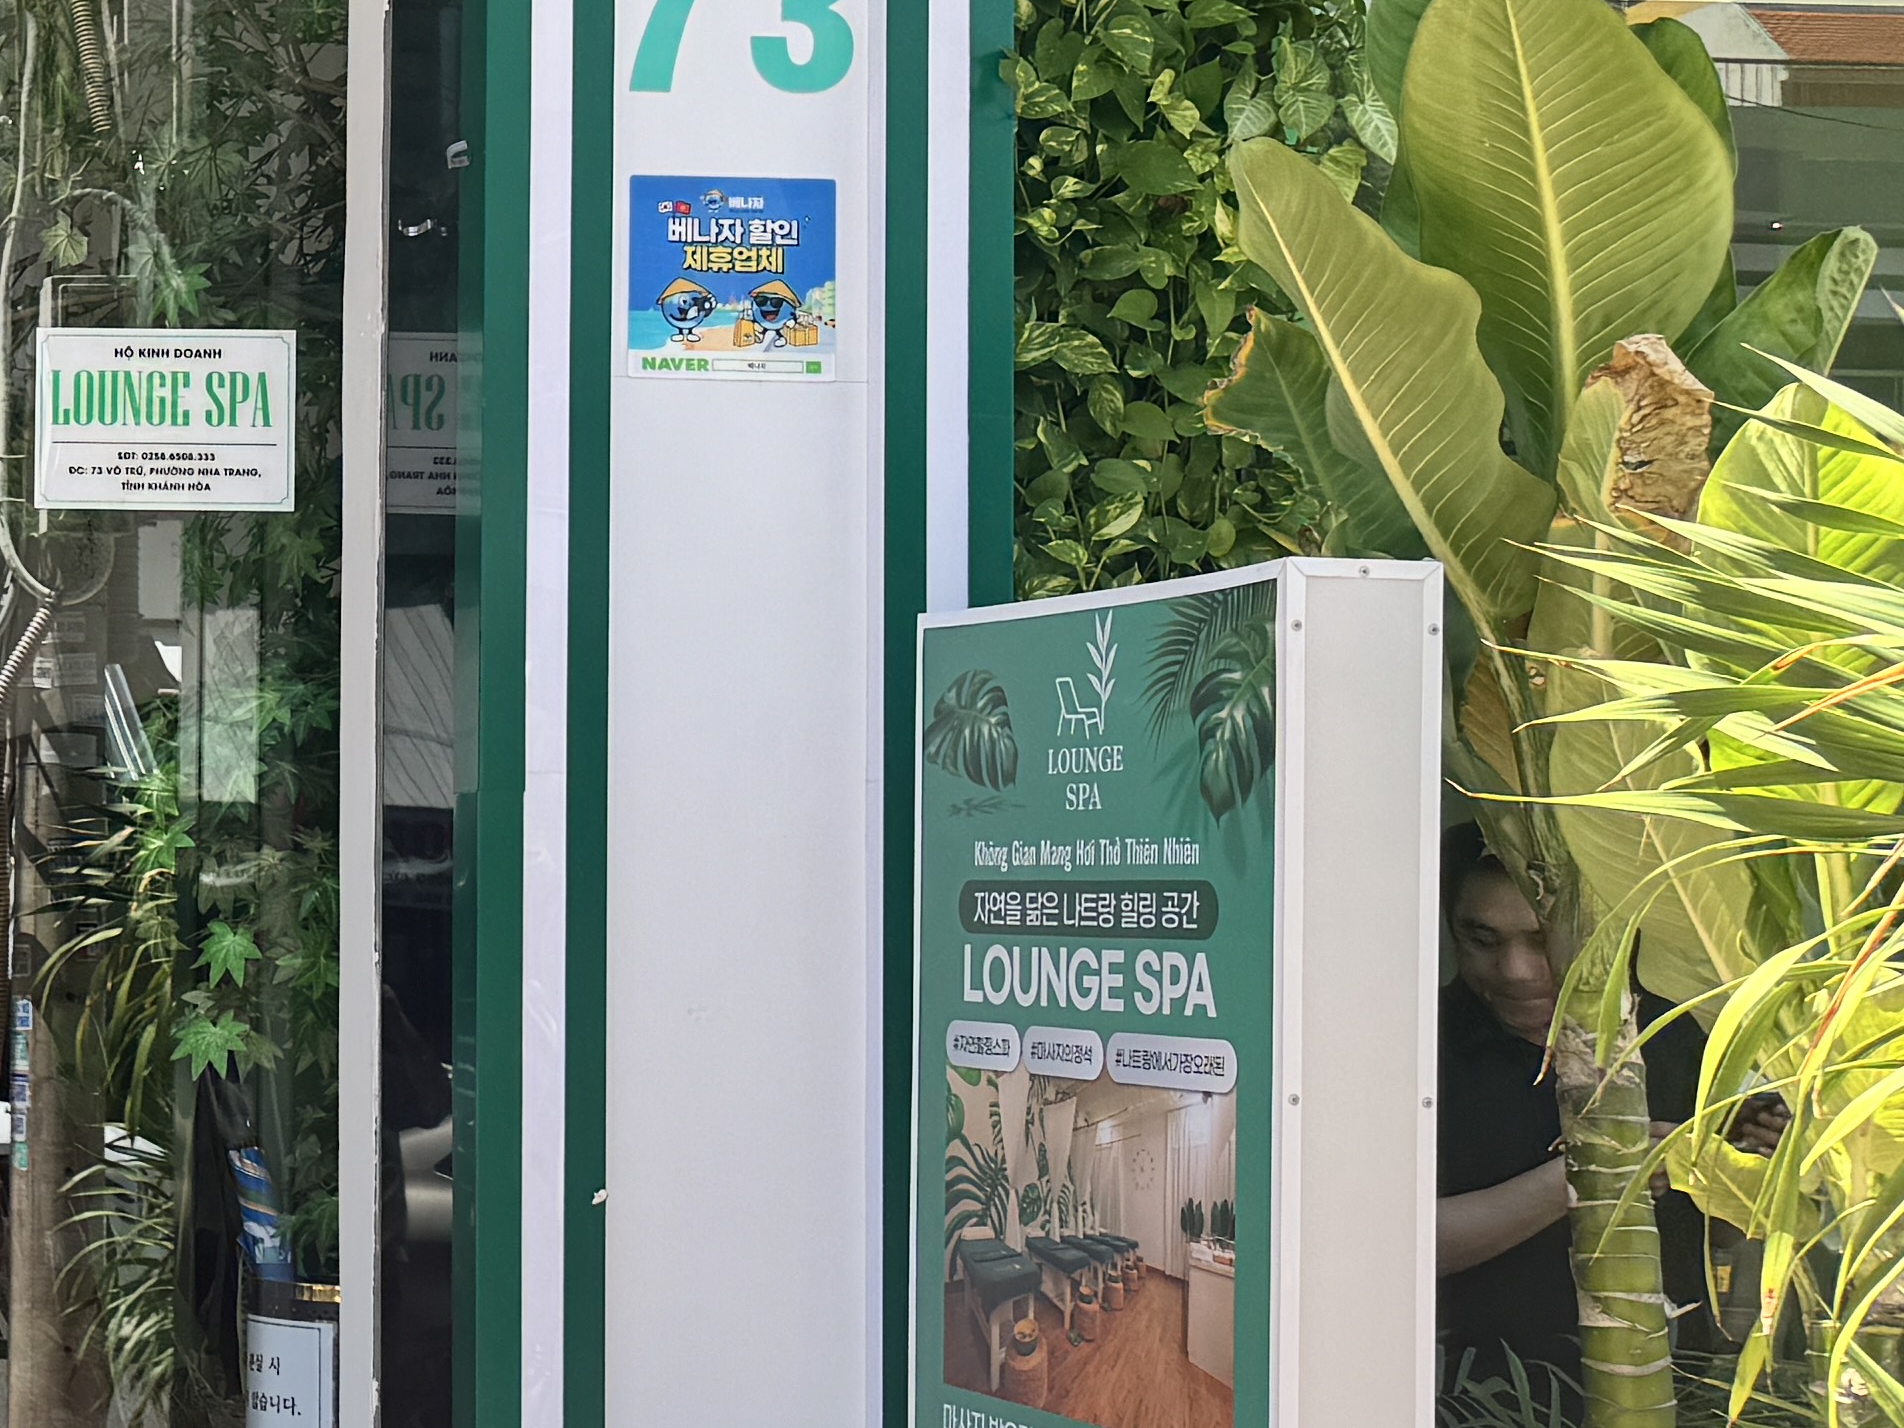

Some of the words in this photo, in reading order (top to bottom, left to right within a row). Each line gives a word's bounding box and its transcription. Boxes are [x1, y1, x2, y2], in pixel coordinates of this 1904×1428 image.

[667, 216, 744, 245] 베나자
[748, 219, 800, 246] 할인
[683, 245, 785, 273] 제휴업체
[114, 345, 134, 362] HỘ
[138, 348, 170, 360] KINH
[174, 348, 222, 360] DOANH
[642, 356, 710, 372] NAVER
[50, 369, 191, 428] LOUNGE
[205, 370, 273, 429] SPA
[91, 466, 102, 475] 73
[198, 467, 221, 476] NHA
[224, 468, 262, 478] TRANG,
[1048, 745, 1124, 775] LOUNGE
[1065, 782, 1102, 811] SPA
[1012, 840, 1036, 866] Gian
[1040, 839, 1072, 872] Mang
[1125, 838, 1158, 865] Thiên
[1163, 837, 1200, 866] Nhiên
[974, 890, 1022, 926] 자연을
[1025, 891, 1059, 926] 닮은
[1063, 892, 1116, 928] 나트랑
[1120, 892, 1156, 928] 힐링
[1161, 890, 1200, 929] 공간
[964, 944, 1125, 1012] LOUNGE
[1134, 949, 1218, 1018] SPA
[268, 1356, 280, 1376] 시
